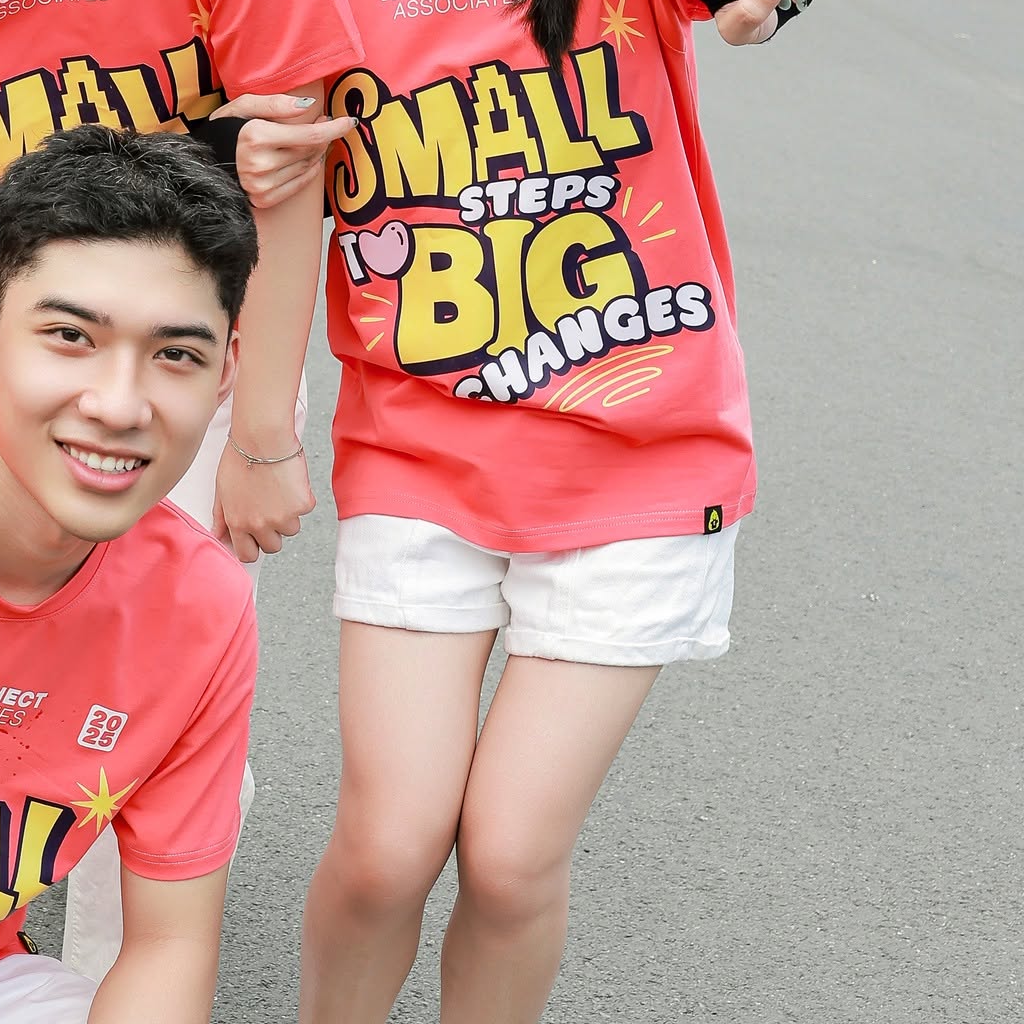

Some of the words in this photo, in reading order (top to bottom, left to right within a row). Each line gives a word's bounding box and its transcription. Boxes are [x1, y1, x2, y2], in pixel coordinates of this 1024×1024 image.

[330, 43, 648, 219] SMALL
[458, 174, 618, 224] STEPS
[398, 212, 638, 366] BIG
[454, 283, 711, 403] CHANGES
[82, 728, 116, 748] 25
[91, 709, 124, 731] 20
